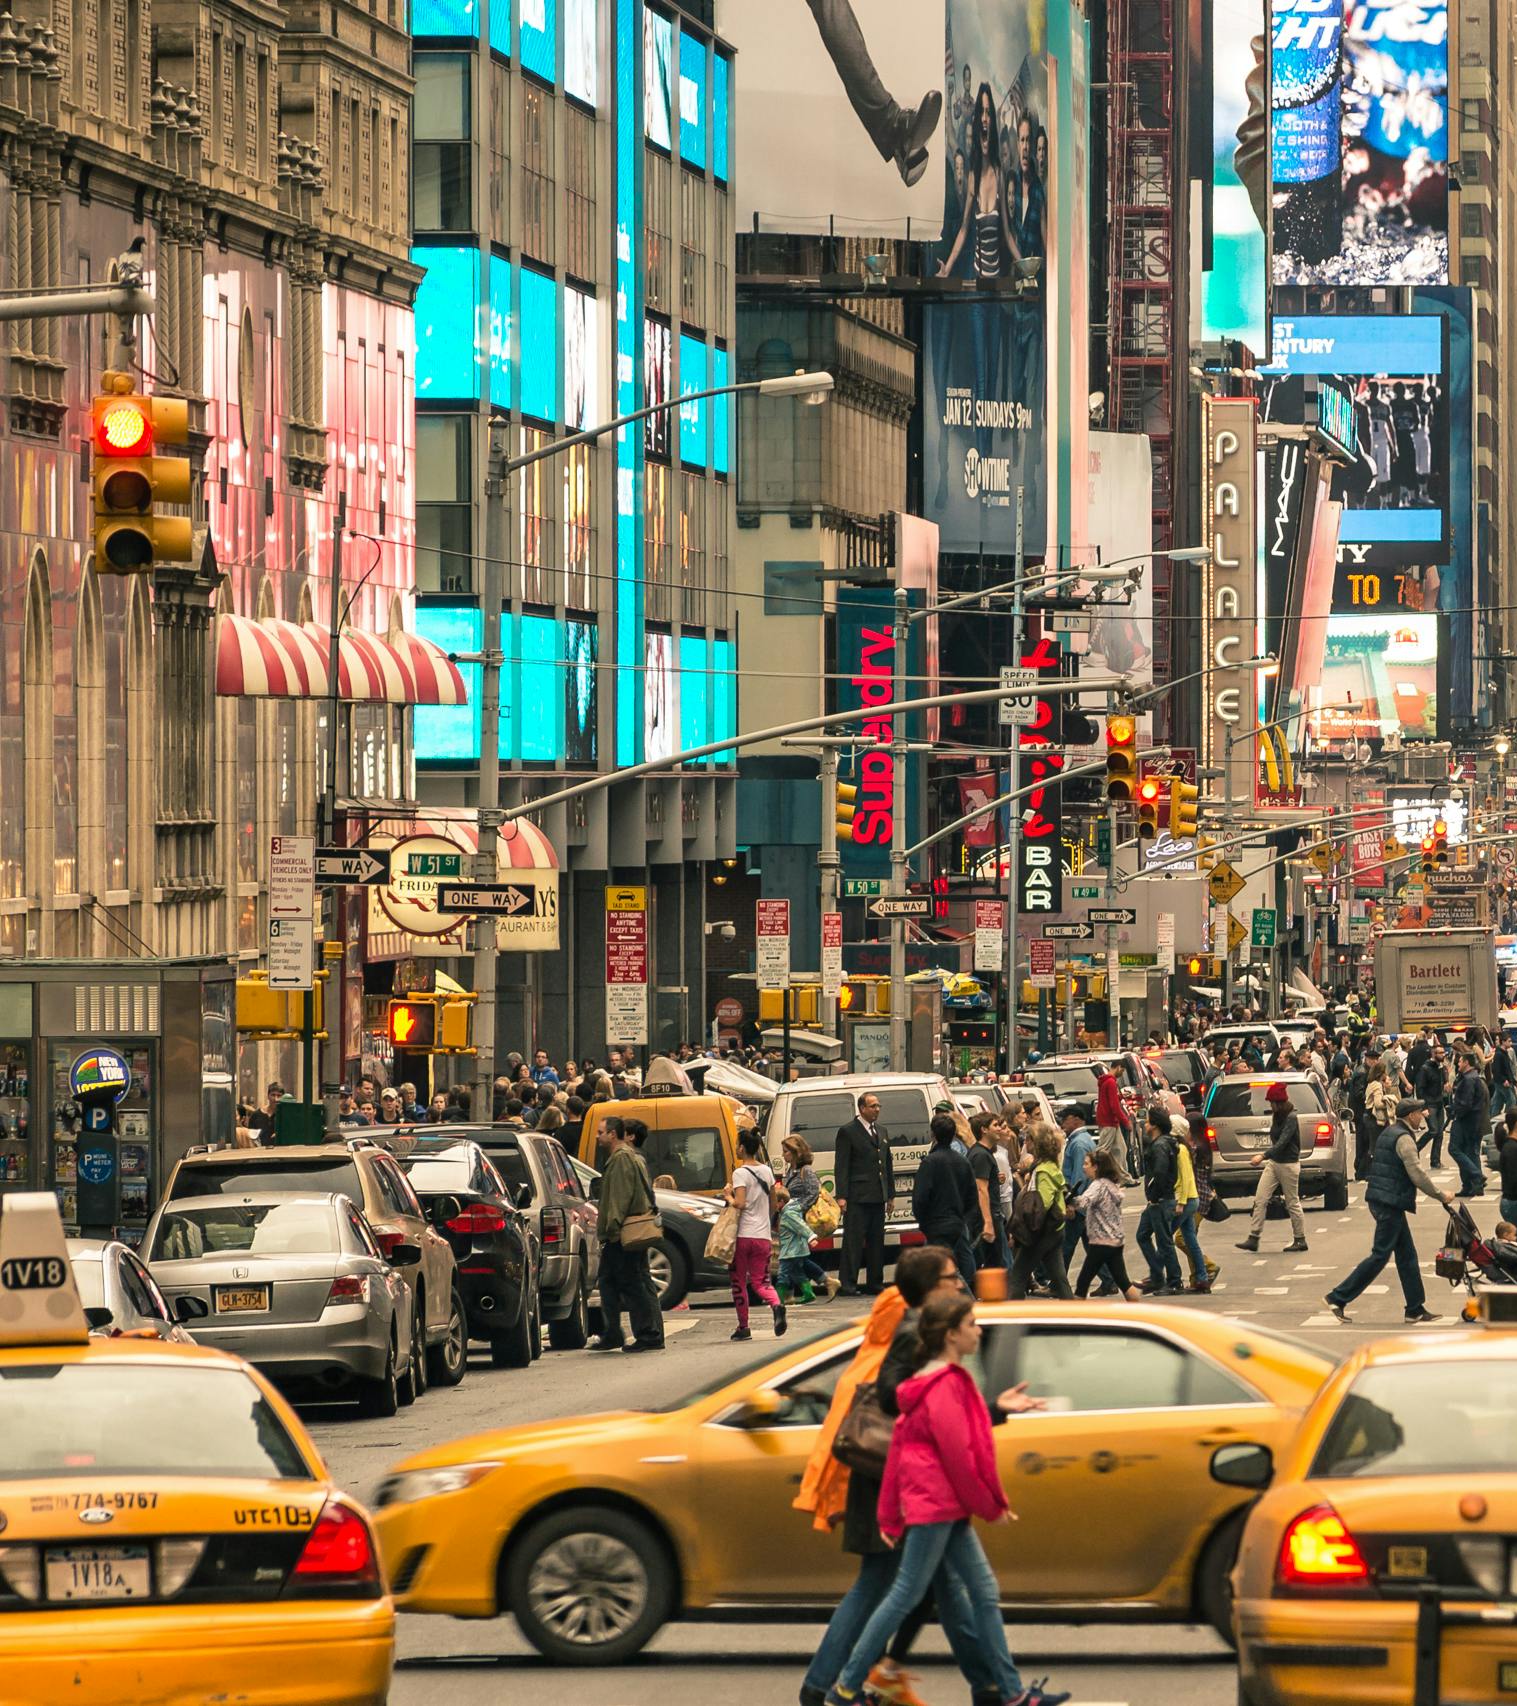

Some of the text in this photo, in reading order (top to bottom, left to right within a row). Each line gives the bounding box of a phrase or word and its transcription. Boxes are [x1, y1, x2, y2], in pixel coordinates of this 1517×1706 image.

[943, 398, 972, 426] JAN 12
[975, 400, 1031, 429] SUNDAYS 9PM
[964, 447, 1010, 498] SHOWTIME
[1214, 431, 1239, 721] PALACE
[1347, 575, 1381, 605] TO
[1003, 671, 1035, 679] SPEED
[1006, 680, 1030, 689] LIMIT
[1353, 829, 1385, 843] JERSEY
[272, 838, 281, 854] 3
[1145, 832, 1193, 858] Lace
[1358, 842, 1382, 859] BOYS
[272, 857, 307, 866] COMMERCIAL
[341, 860, 374, 873] WAY
[411, 856, 456, 873] W 51 ST
[298, 867, 312, 875] ONLY
[1025, 845, 1052, 910] BAR
[847, 881, 854, 893] W
[857, 881, 868, 894] 50
[1073, 888, 1079, 897] W
[1081, 887, 1090, 897] 49
[451, 893, 521, 906] ONE WAY
[878, 902, 923, 912] ONE WAY
[271, 921, 279, 936] 6
[1049, 927, 1065, 935] ONE
[1410, 963, 1461, 979] Bartlett
[98, 1057, 118, 1067] NEW
[101, 1067, 124, 1081] YORK
[92, 1107, 106, 1129] P
[84, 1154, 92, 1166] P
[2, 1260, 61, 1286] 1V18
[71, 1492, 158, 1511] 774-9767
[234, 1506, 313, 1526] UTC103
